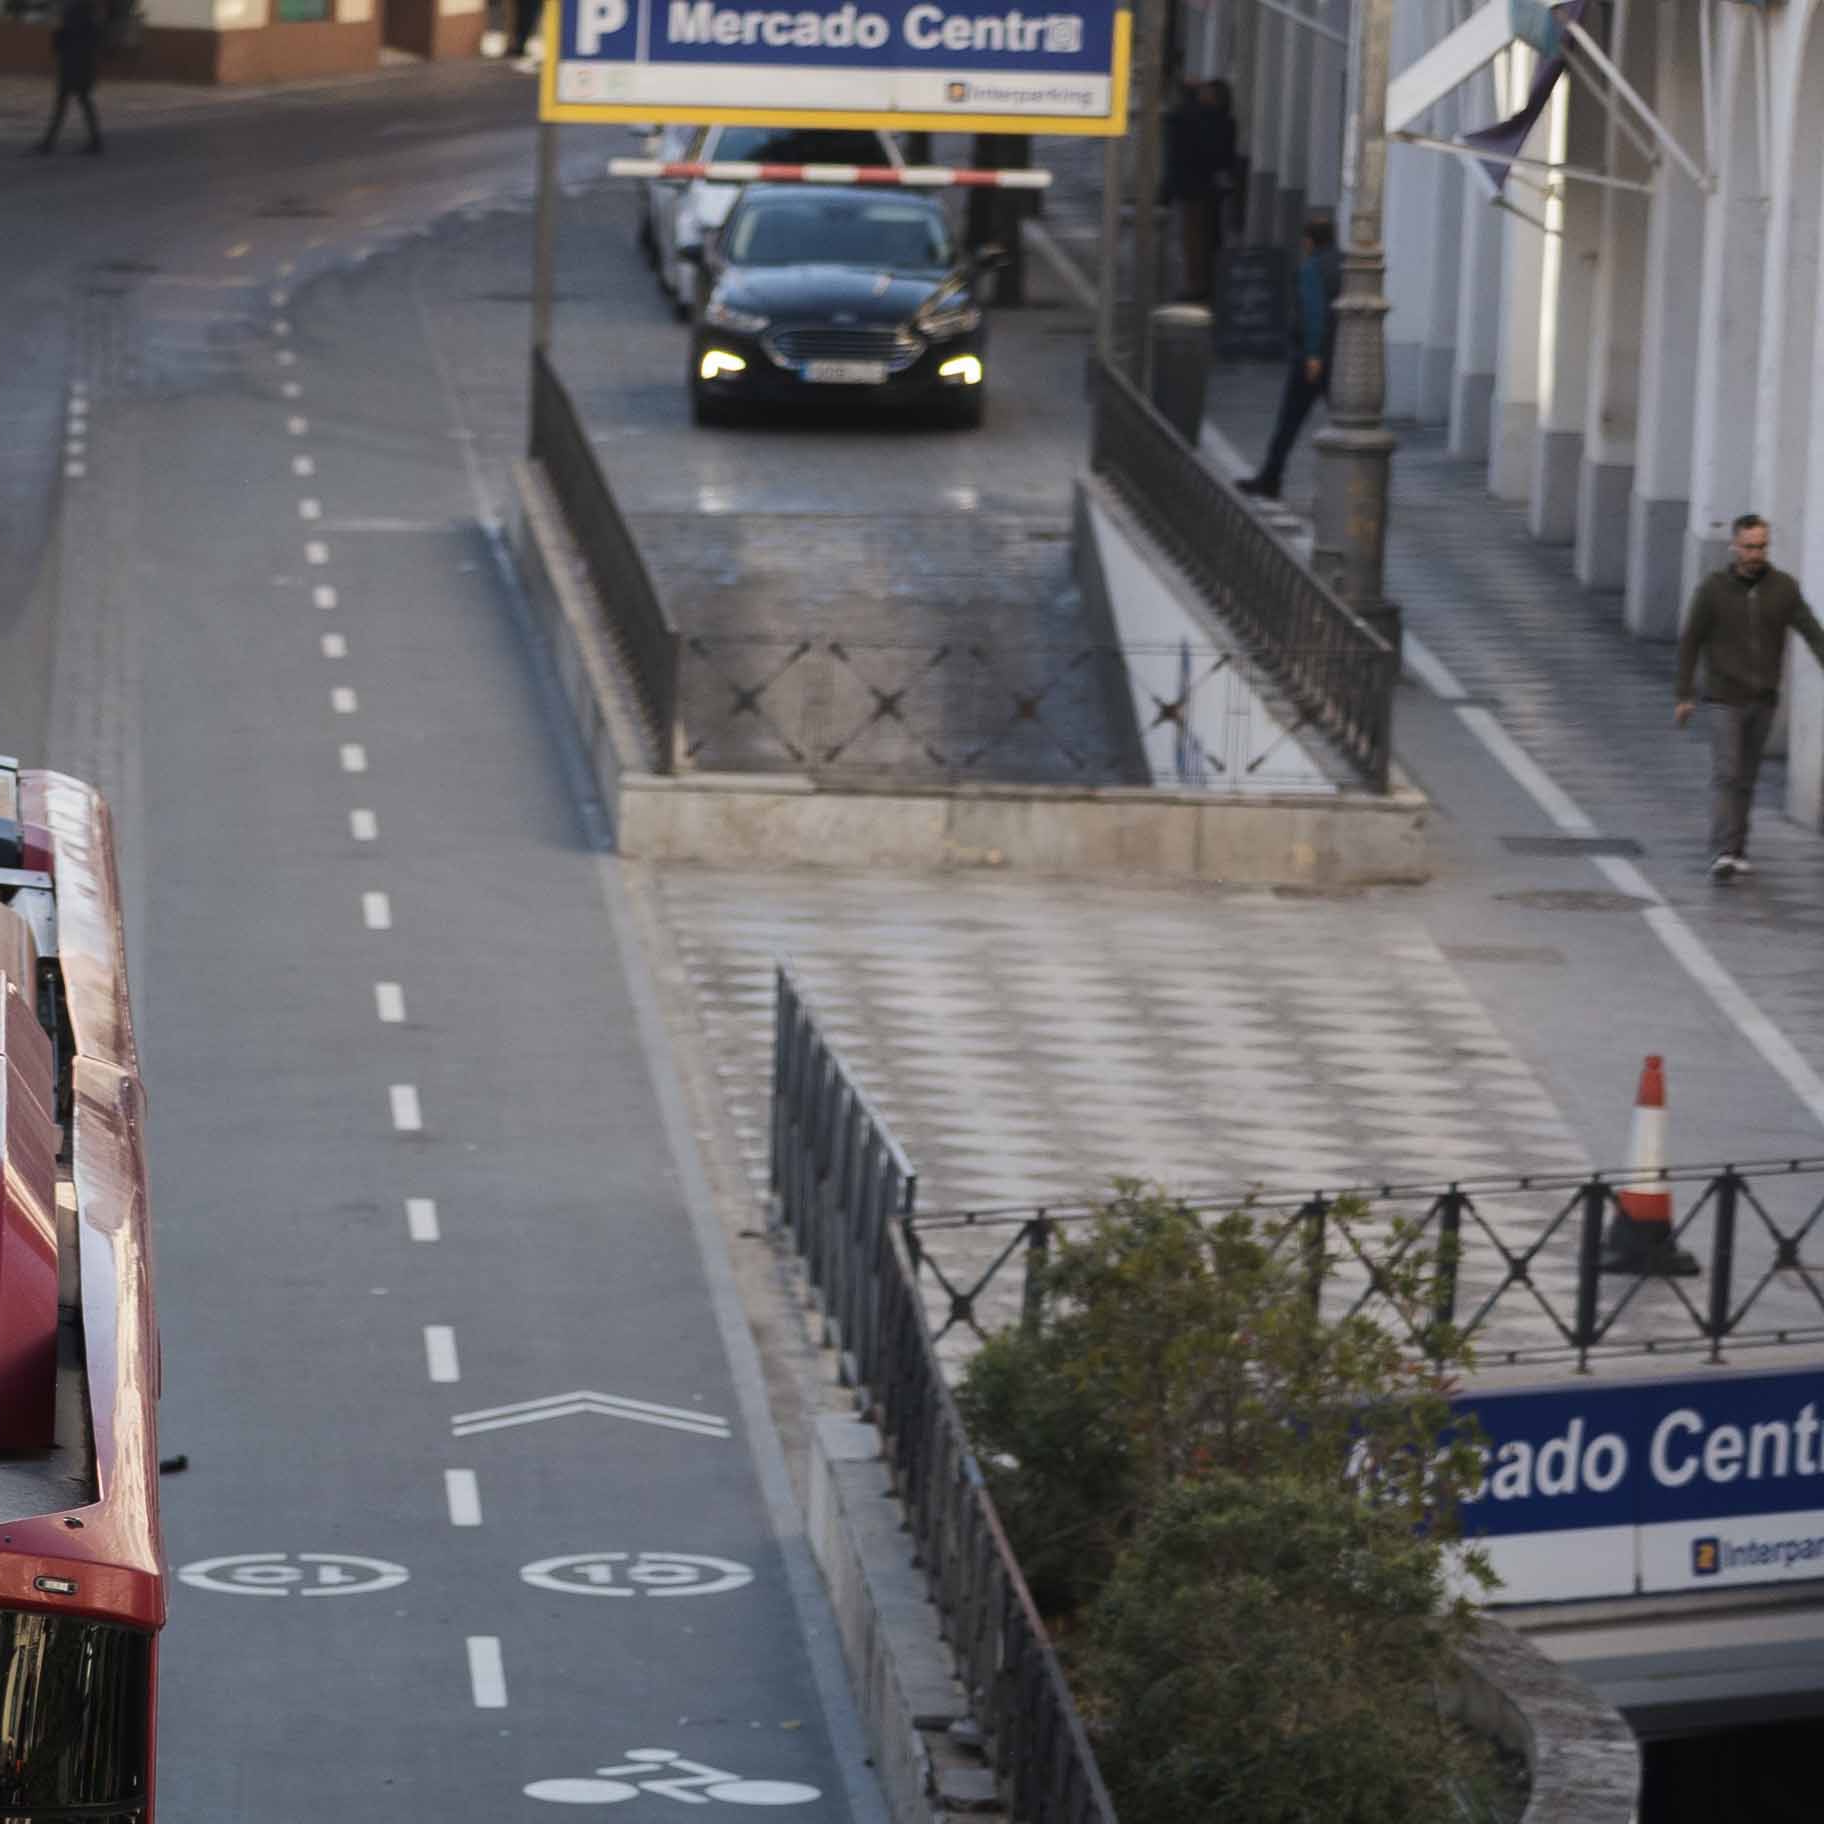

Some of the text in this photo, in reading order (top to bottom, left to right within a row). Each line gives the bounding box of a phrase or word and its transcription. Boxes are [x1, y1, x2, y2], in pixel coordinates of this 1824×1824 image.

[576, 0, 1083, 56] P Mercado Centr
[1651, 1402, 1824, 1488] Cent
